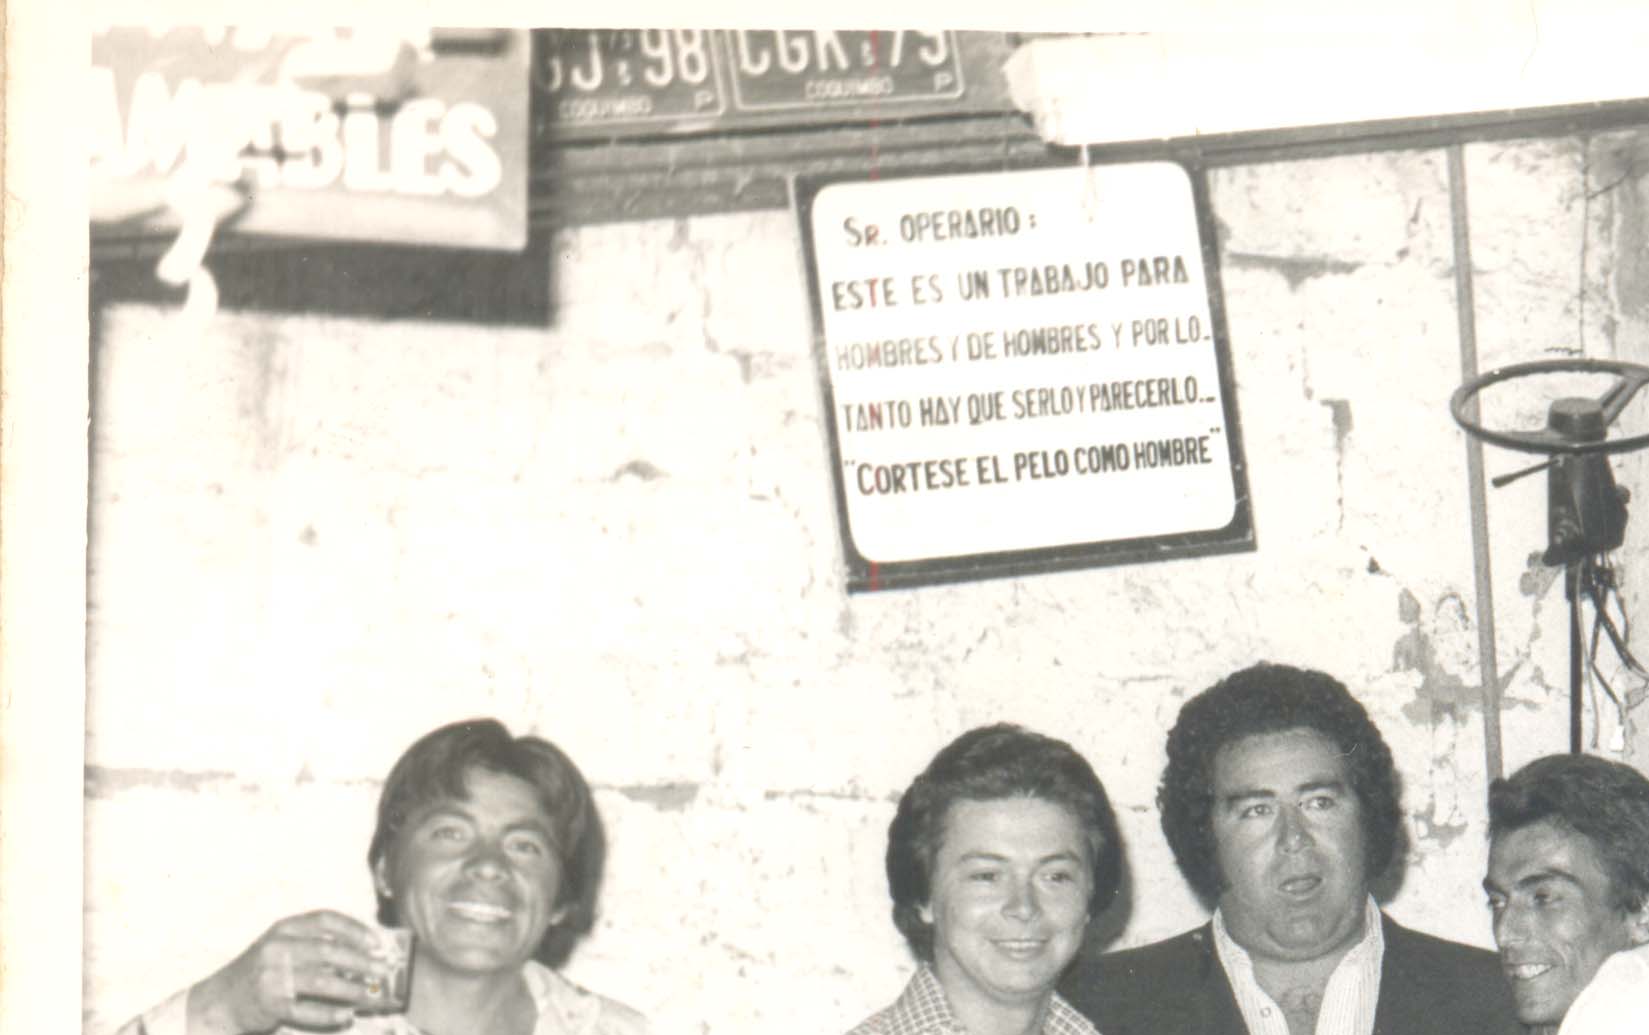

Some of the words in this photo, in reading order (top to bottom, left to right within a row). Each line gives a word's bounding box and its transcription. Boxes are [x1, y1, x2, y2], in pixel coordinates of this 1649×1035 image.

[832, 278, 896, 311] ESTE
[912, 275, 942, 304] ES
[958, 270, 989, 301] UN
[998, 262, 1109, 298] TRABAJO
[1121, 256, 1189, 287] PARA
[836, 335, 943, 371] HOMBRES
[967, 332, 996, 361] DE
[1003, 324, 1101, 357] HOMBRES
[1112, 322, 1122, 349] Y
[1132, 317, 1169, 347] POR
[844, 400, 912, 432] TANTO
[919, 396, 961, 427] HAY
[968, 391, 1006, 426] QUE
[1012, 386, 1073, 419] SERLO
[1076, 387, 1085, 412] Y
[976, 455, 1008, 485] EL
[1014, 450, 1069, 482] PELO
[1074, 443, 1130, 475] COMO
